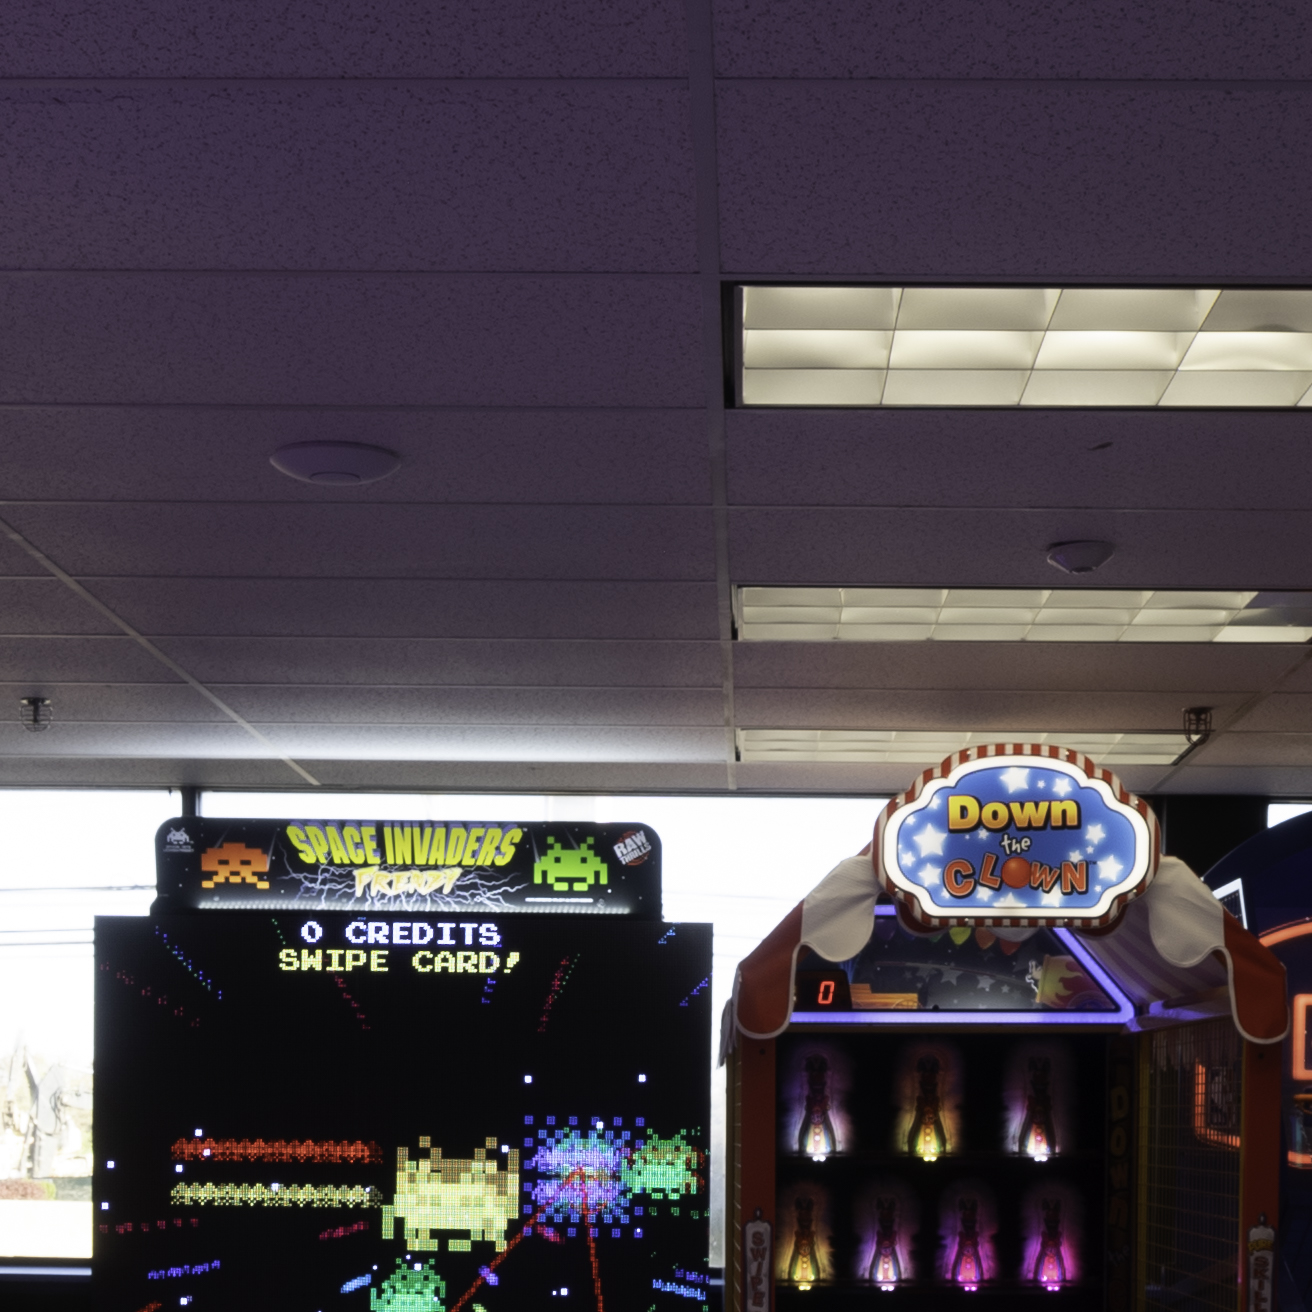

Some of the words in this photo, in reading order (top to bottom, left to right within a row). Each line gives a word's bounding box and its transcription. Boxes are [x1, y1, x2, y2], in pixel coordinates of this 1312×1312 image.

[948, 795, 1079, 831] Down
[287, 823, 382, 864] SPACE
[385, 824, 522, 867] INVADERS
[613, 830, 646, 857] RAW
[1001, 834, 1031, 855] the
[944, 853, 1088, 897] CLOWN
[301, 921, 323, 943] 0
[346, 921, 501, 945] CREDITS
[279, 949, 389, 972] SWIPE
[412, 951, 520, 974] CARD!
[818, 980, 835, 1005] 0
[750, 1231, 767, 1307] SWIPE
